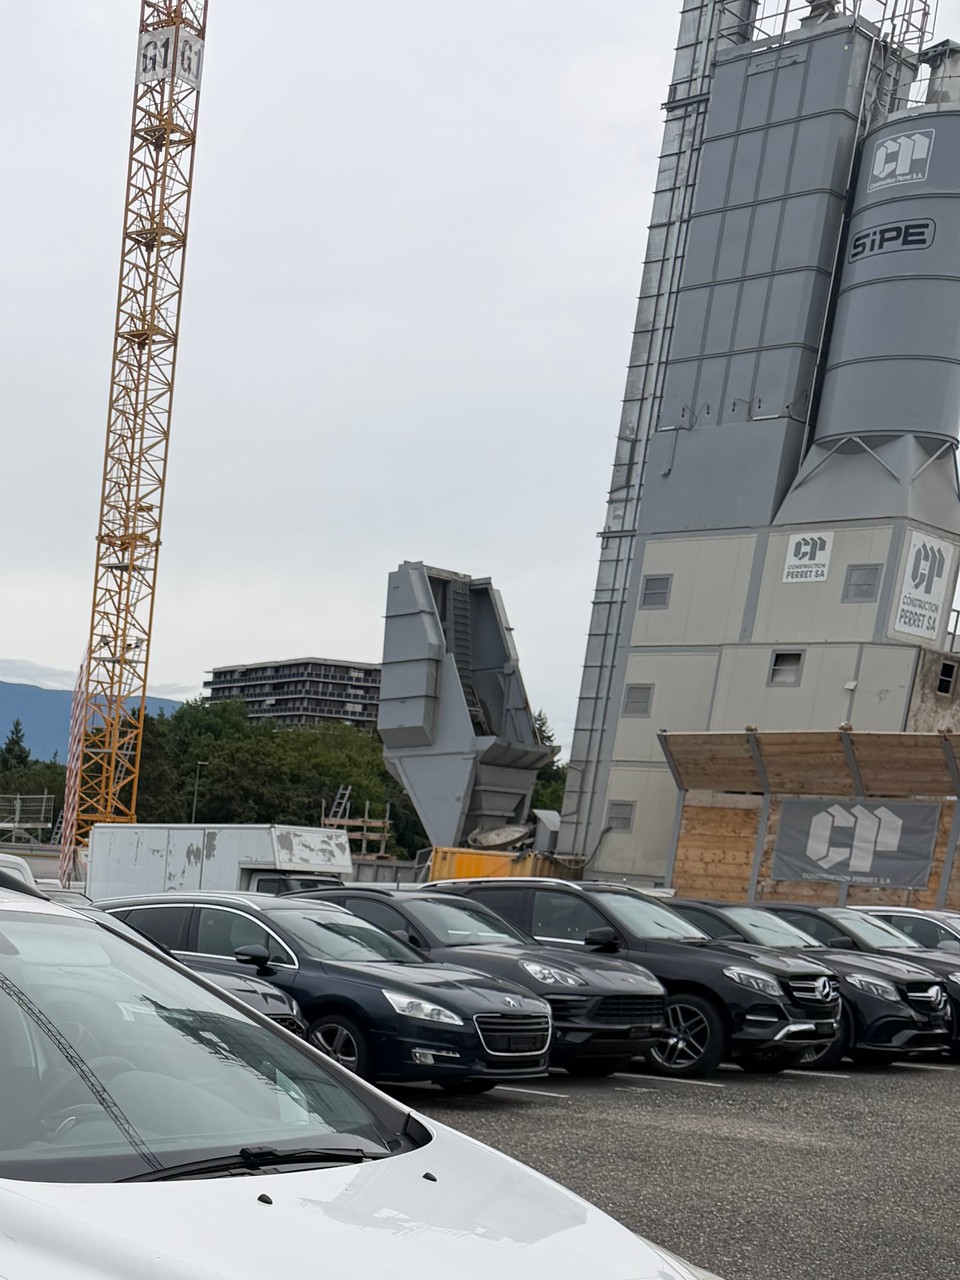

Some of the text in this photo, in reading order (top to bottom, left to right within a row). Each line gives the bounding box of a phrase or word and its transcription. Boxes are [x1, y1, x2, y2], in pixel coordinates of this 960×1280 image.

[142, 37, 170, 74] G1
[180, 39, 201, 80] G1
[785, 569, 825, 579] PERRET SA
[902, 594, 939, 614] CONSTRUCTION
[898, 608, 937, 632] PERRET SA
[802, 872, 851, 881] CONSTRUCTION
